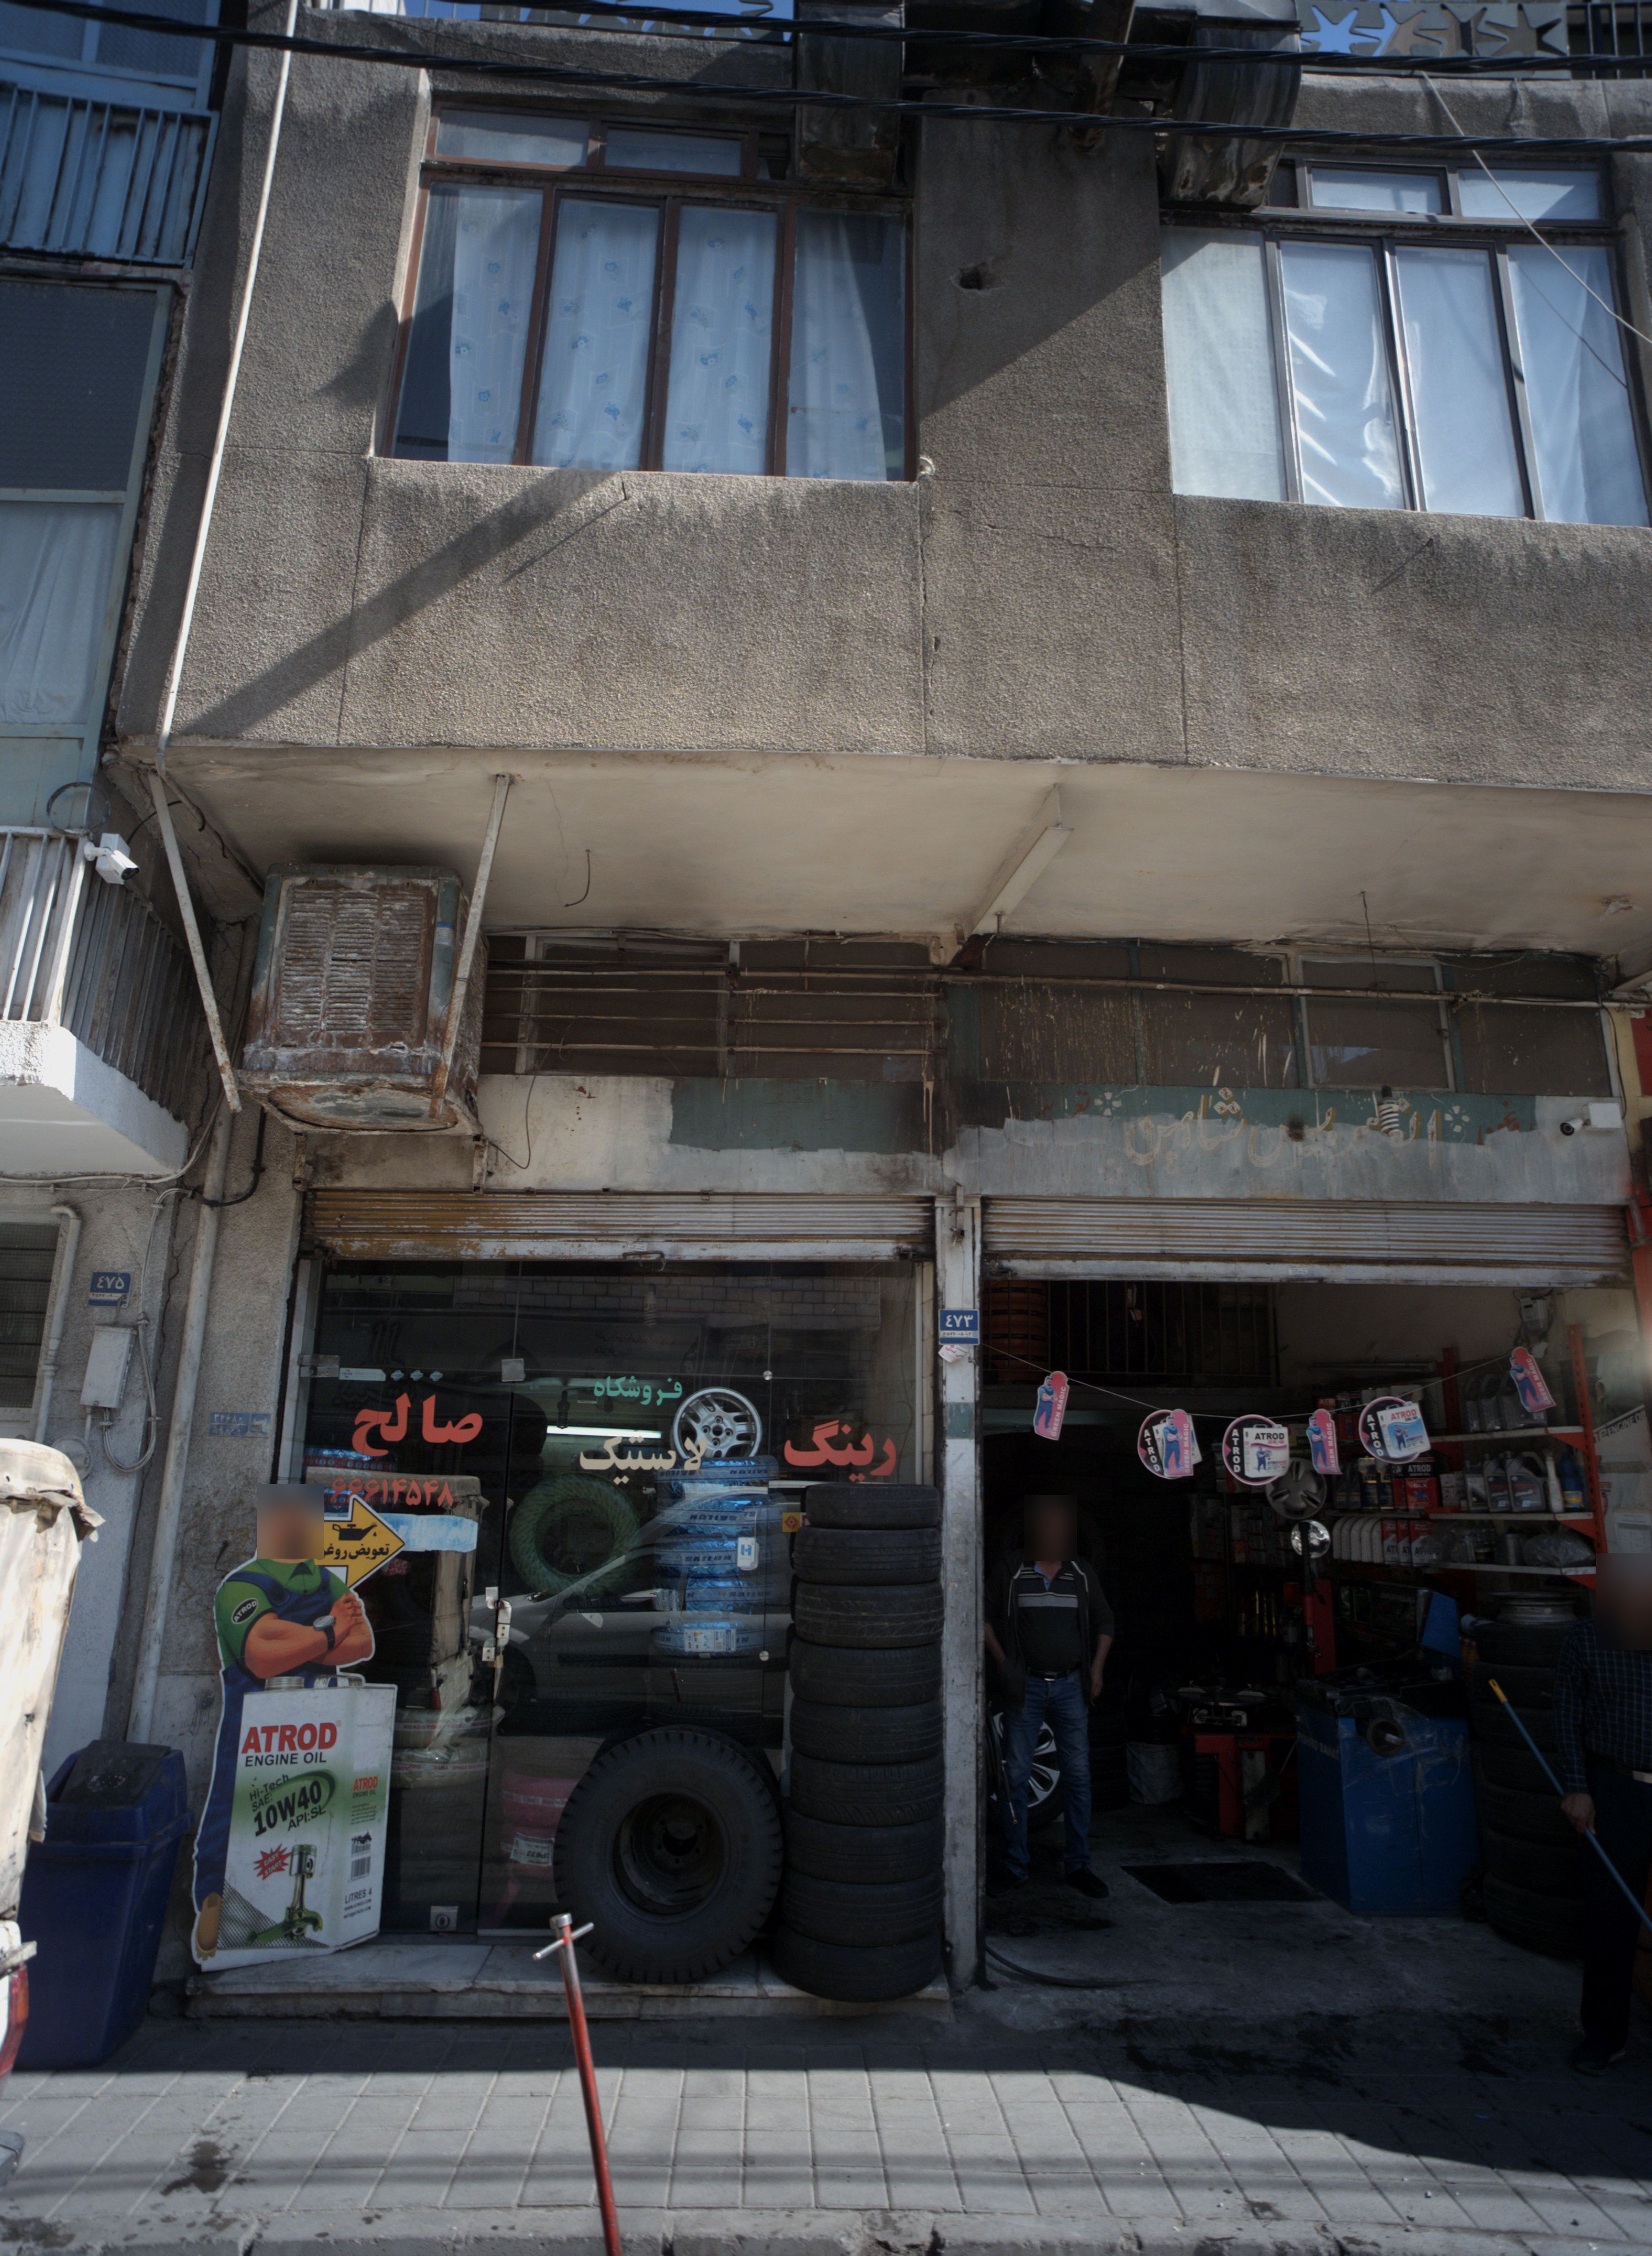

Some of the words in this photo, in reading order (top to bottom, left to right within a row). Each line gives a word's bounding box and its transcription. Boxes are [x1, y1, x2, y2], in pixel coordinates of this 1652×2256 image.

[352, 1392, 483, 1457] صالح
[1390, 1409, 1417, 1422] ATROD
[1254, 1432, 1285, 1440] ATROD
[1367, 1414, 1384, 1457] ATROD
[579, 1434, 708, 1484] لاستیک
[784, 1419, 896, 1482] رینگ
[1144, 1429, 1162, 1472] ATROD
[1231, 1428, 1241, 1473] ATROD
[1408, 1464, 1432, 1473] ATROD
[324, 1543, 349, 1560] روغ
[349, 1543, 390, 1560] تعویض
[233, 1599, 257, 1623] ATROD
[241, 1722, 338, 1754] ATROD
[245, 1753, 298, 1767] ENGINE
[303, 1751, 327, 1764] OIL
[249, 1774, 290, 1801] Hi-Tech
[352, 1775, 379, 1792] ATROD
[252, 1793, 274, 1812] SAE:
[254, 1780, 322, 1837] 10W40
[287, 1804, 327, 1831] API:SL
[264, 1852, 279, 1867] EASY
[264, 1859, 282, 1877] START
[344, 1889, 367, 1905] LITRES
[368, 1887, 372, 1896] 4
